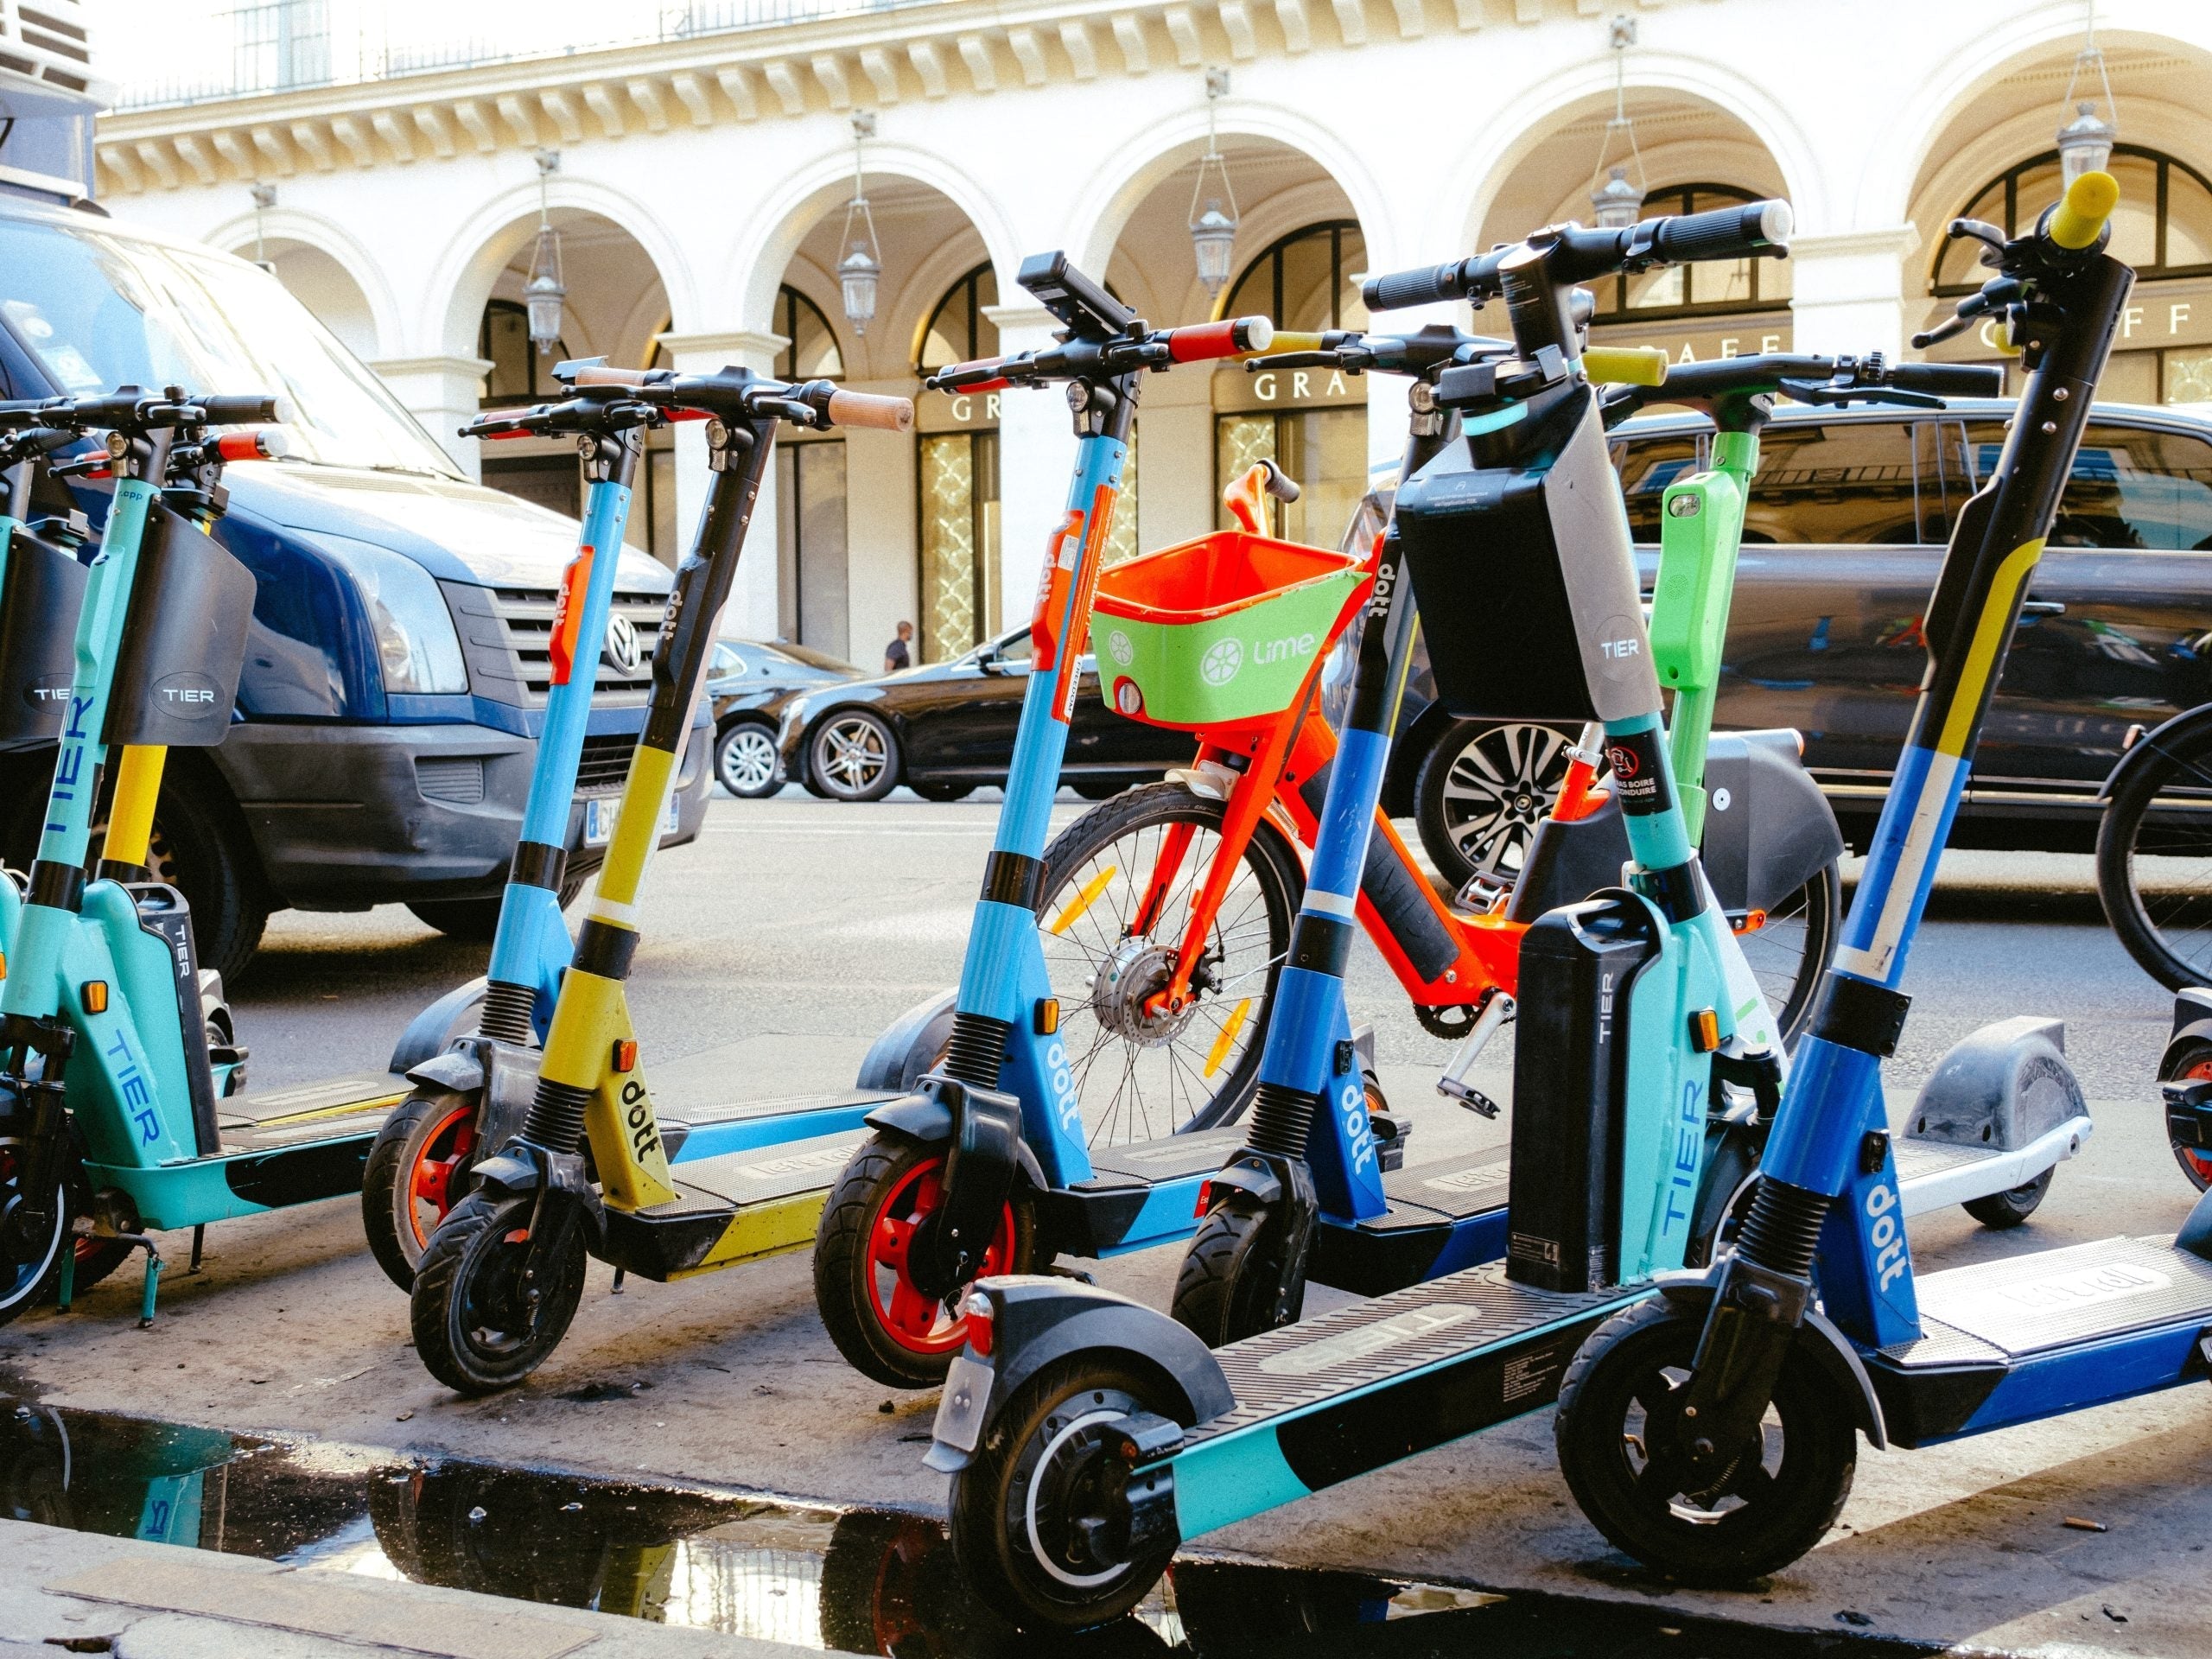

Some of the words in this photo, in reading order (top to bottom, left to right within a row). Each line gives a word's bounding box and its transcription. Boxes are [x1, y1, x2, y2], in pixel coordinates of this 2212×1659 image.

[551, 582, 570, 626] dott
[1035, 553, 1057, 603] dott
[1368, 563, 1396, 617] dott
[658, 590, 683, 641] dott
[1601, 639, 1639, 659] TIER
[162, 689, 214, 702] TIER
[46, 696, 94, 832] TIER
[1629, 778, 1655, 788] BOIRE
[175, 925, 190, 978] TIER
[1599, 971, 1614, 1045] TIER
[107, 1028, 160, 1147] TIER
[1047, 1043, 1078, 1131] dott
[621, 1080, 658, 1163] dott
[1341, 1084, 1374, 1175] dott
[1662, 1079, 1703, 1236] TIER
[1866, 1185, 1907, 1293] dott
